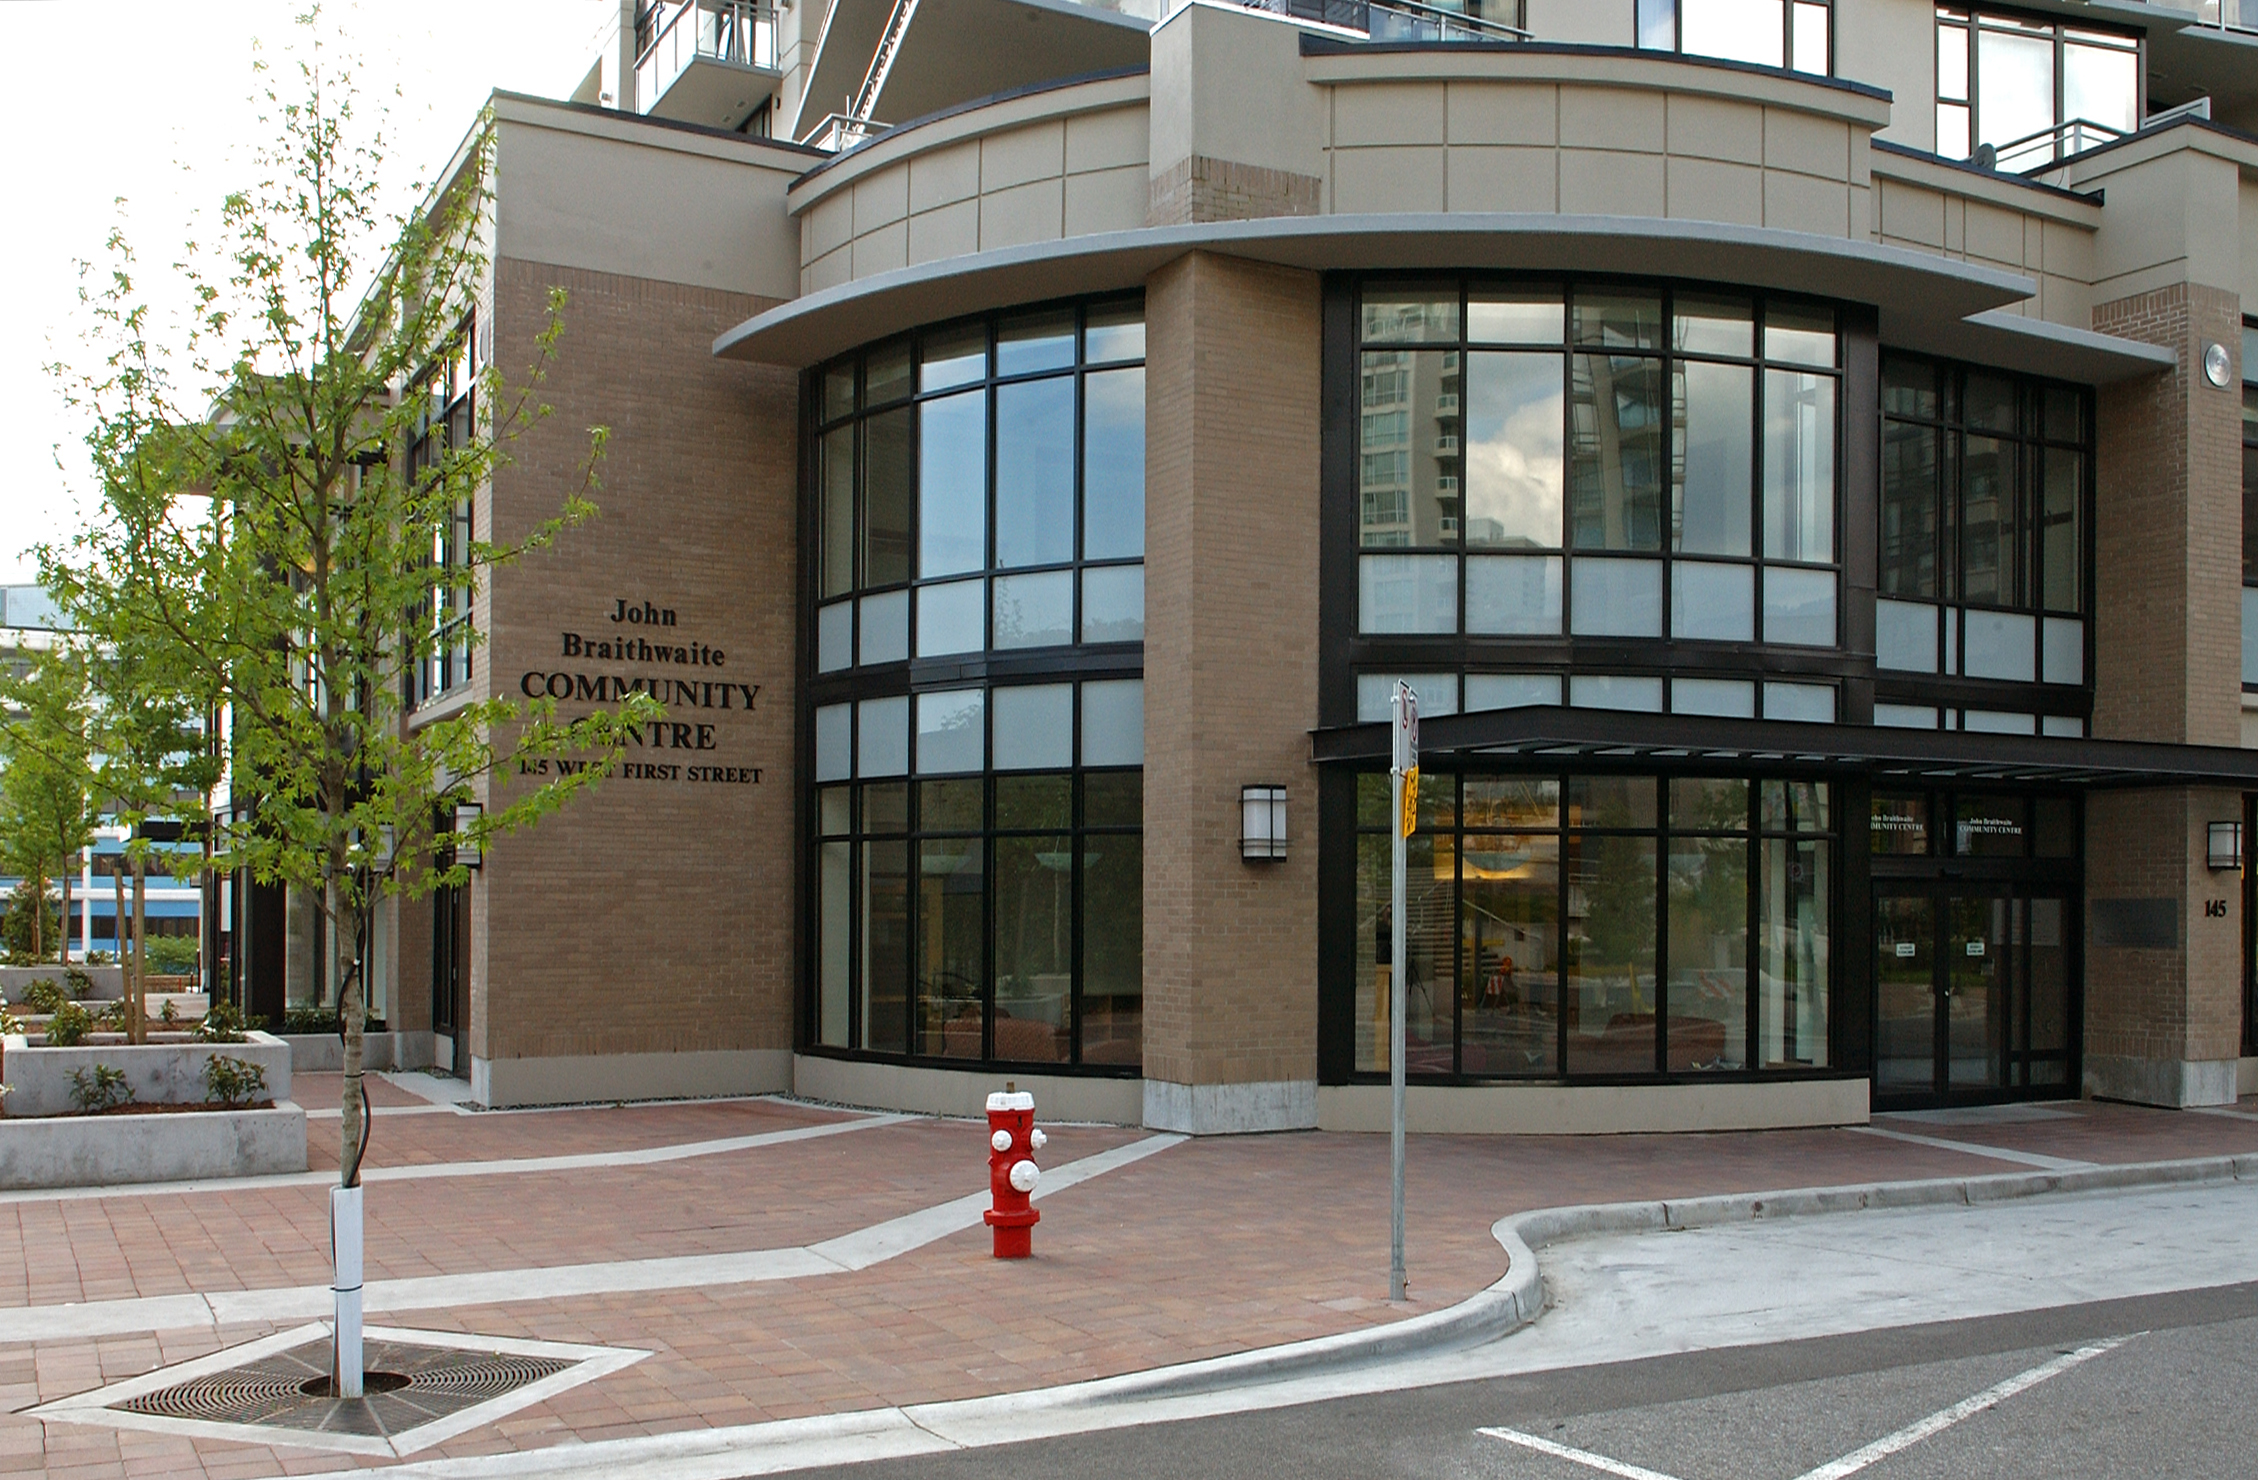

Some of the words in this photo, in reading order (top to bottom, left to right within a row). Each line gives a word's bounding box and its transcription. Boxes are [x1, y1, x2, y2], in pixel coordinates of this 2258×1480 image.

[611, 599, 677, 626] John
[562, 632, 725, 666] Braithwaite
[520, 671, 761, 710] COMMUNITY
[623, 762, 681, 780] FIRST
[687, 764, 763, 784] STREET
[1898, 823, 1923, 831] CENTRE
[1959, 824, 1997, 833] COMMUNITY
[1998, 826, 2022, 834] CENTRE
[1970, 817, 1982, 825] John
[1983, 818, 2012, 826] Braithwaite
[2205, 899, 2227, 917] 145
